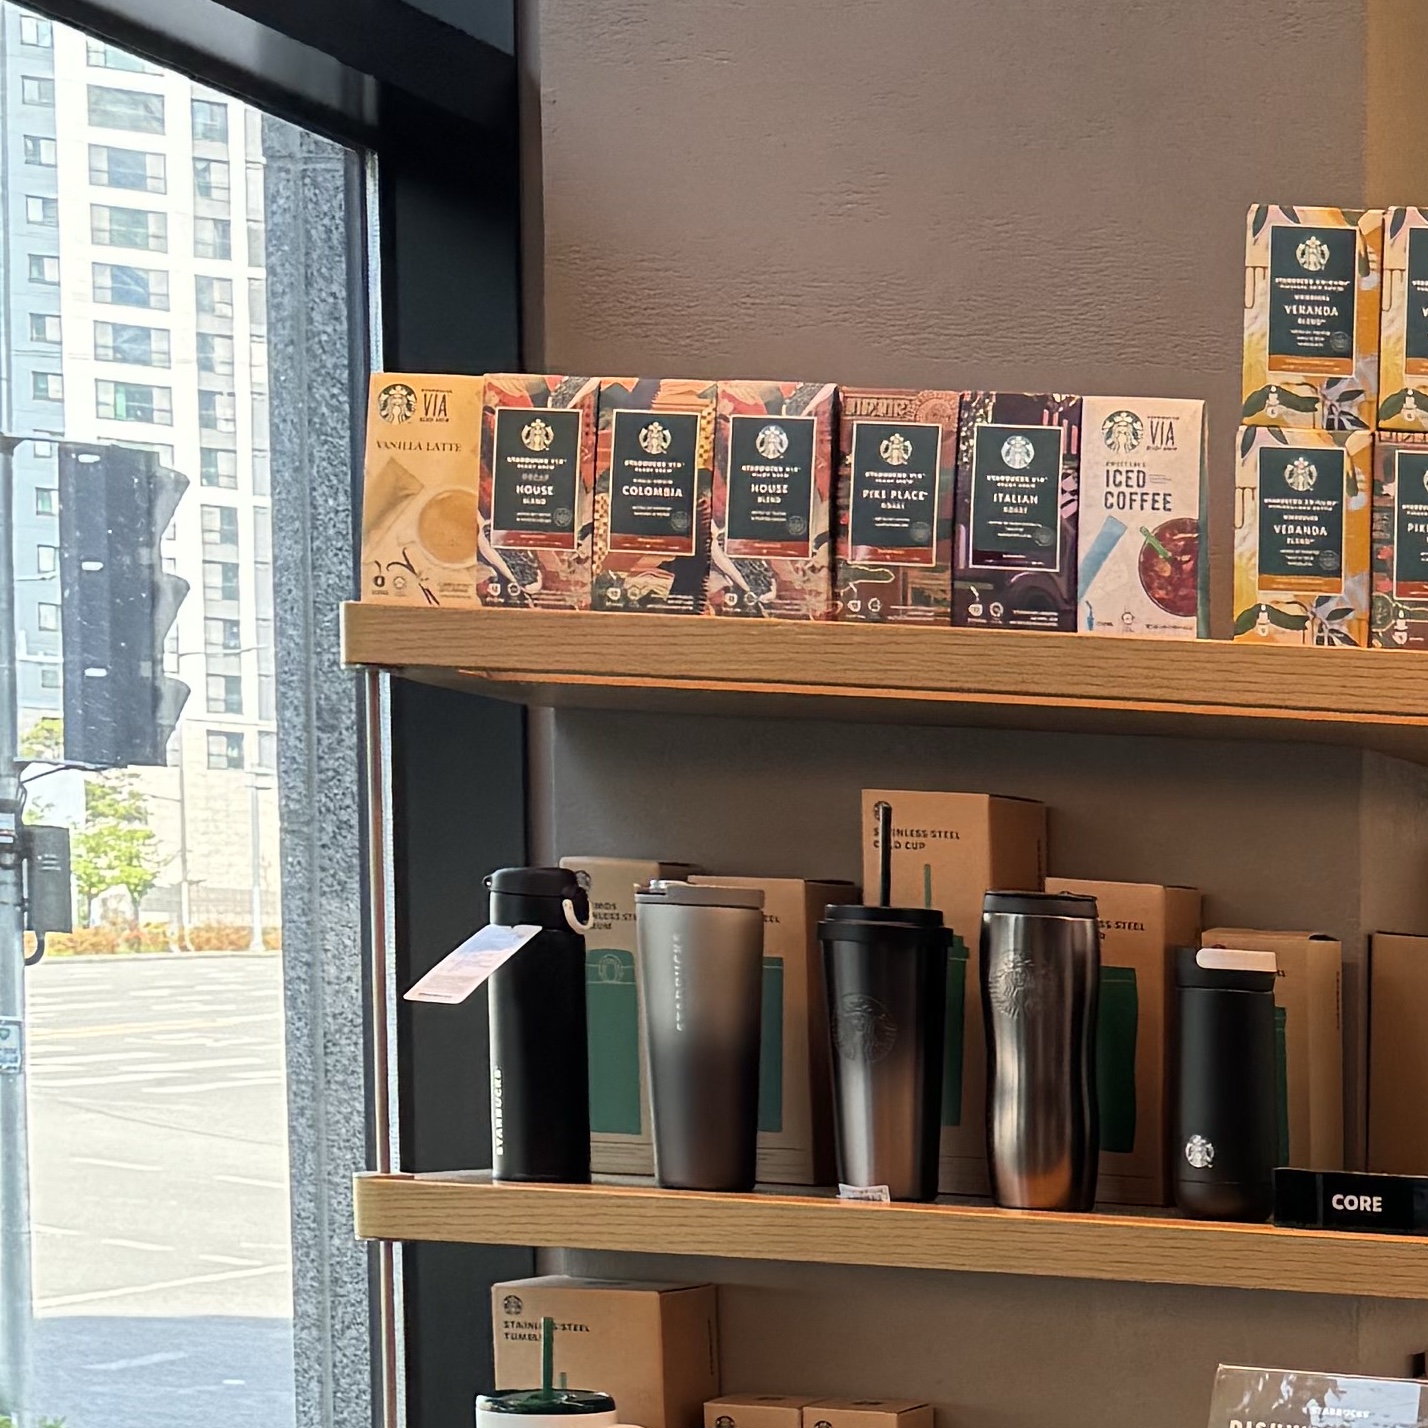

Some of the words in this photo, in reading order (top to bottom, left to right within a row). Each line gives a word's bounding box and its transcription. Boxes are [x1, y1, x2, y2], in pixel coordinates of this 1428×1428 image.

[1284, 305, 1339, 317] VERANDA
[424, 393, 447, 417] VIA
[1150, 420, 1175, 446] VIA
[376, 440, 422, 451] VANILLA
[426, 442, 462, 452] LATTE
[1106, 469, 1146, 488] ICED
[516, 485, 553, 496] HOUSE
[622, 485, 683, 498] COLOMBIA
[751, 484, 788, 494] HOUSE
[862, 489, 887, 500] PIKE
[993, 493, 1039, 505] ITALIAN
[1104, 491, 1172, 512] COFFEE
[1274, 524, 1328, 537] VERANDA
[874, 827, 928, 838] SINLESS
[930, 830, 960, 840] STEEL
[873, 841, 901, 849] CD
[904, 841, 926, 850] CUP
[1115, 920, 1145, 931] STEEL
[672, 933, 685, 1032] STARBUCKS
[494, 1068, 504, 1156] STARBUCKS
[1332, 1194, 1383, 1213] CORE
[503, 1321, 558, 1331] STAINLS
[560, 1323, 590, 1332] STEEL
[504, 1332, 541, 1342] TUMBL
